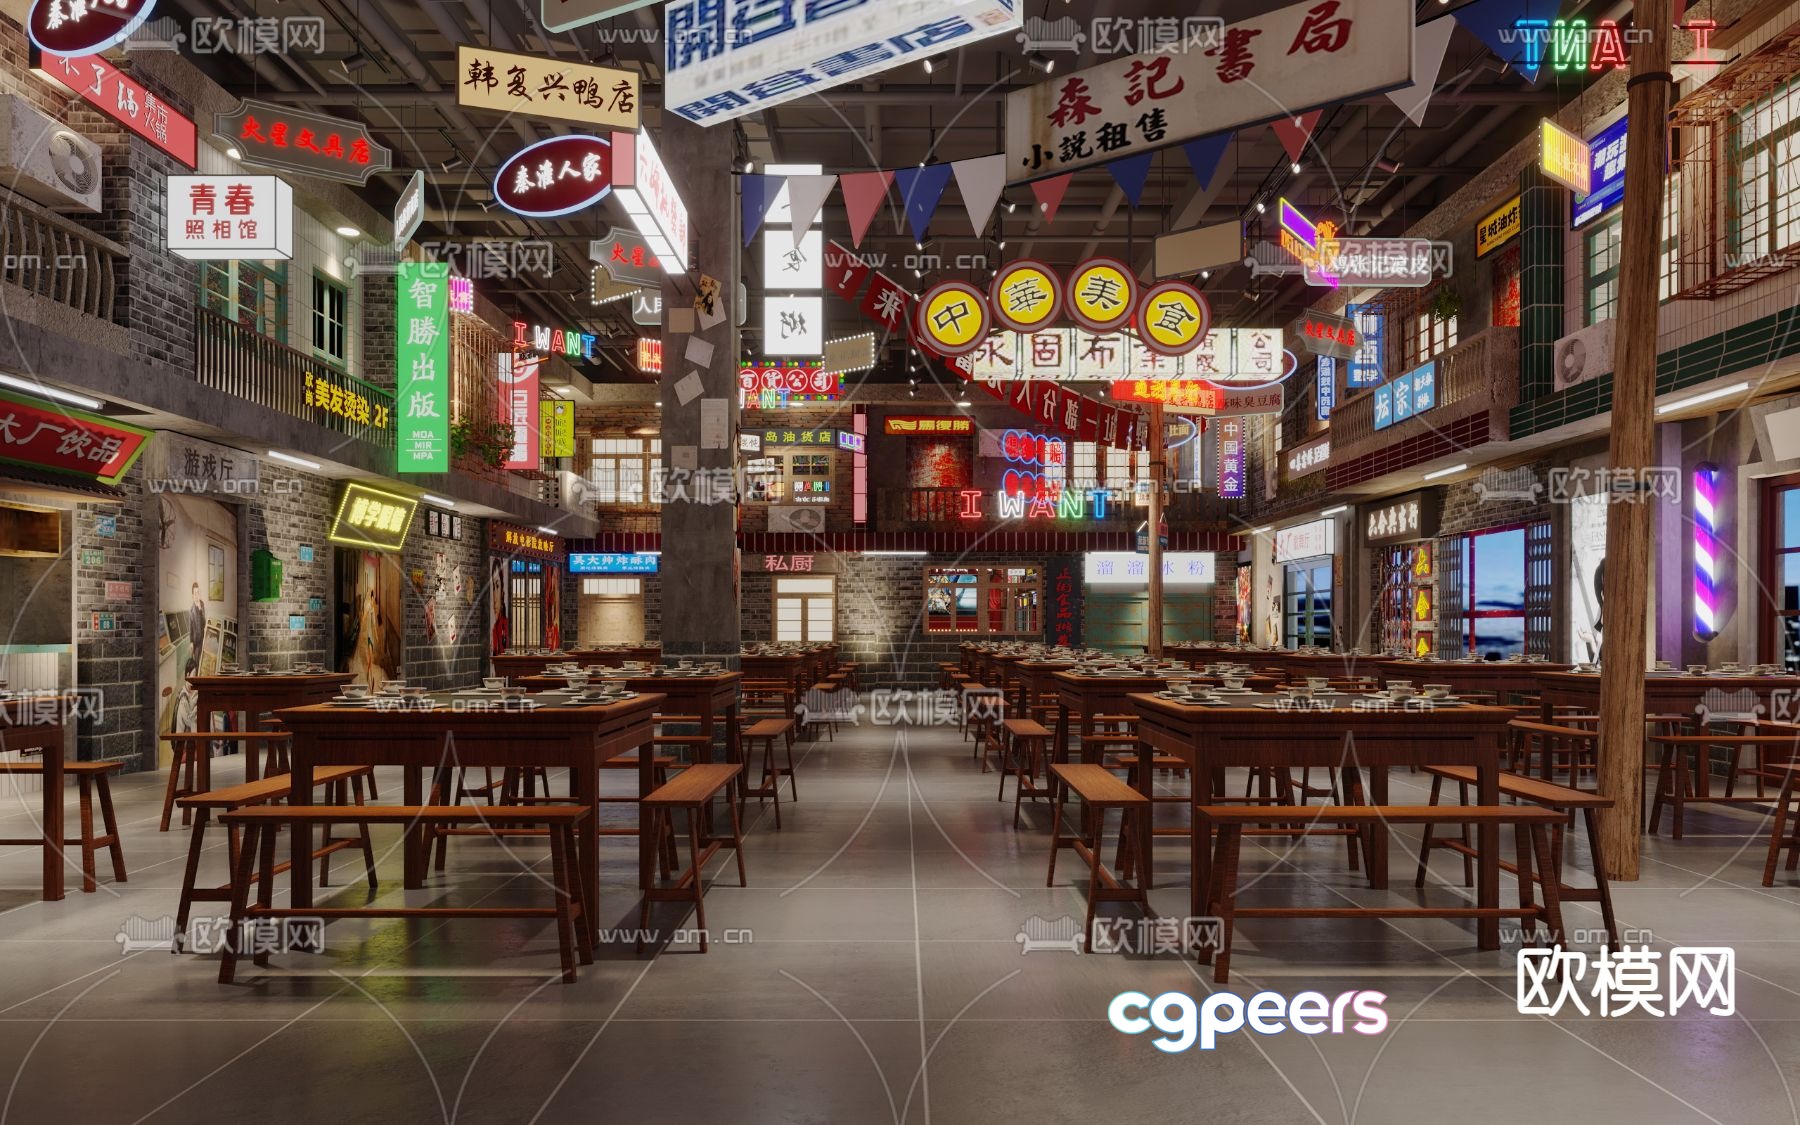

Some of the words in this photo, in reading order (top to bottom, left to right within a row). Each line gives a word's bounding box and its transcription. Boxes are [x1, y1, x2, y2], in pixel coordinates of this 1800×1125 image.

[1046, 1, 1353, 128] 森記書局
[464, 58, 638, 114] 韩复兴鸭店
[241, 116, 371, 165] 火星文具店
[513, 152, 602, 195] 秦淮人家
[189, 183, 255, 216] 青春
[185, 219, 259, 241] 照相馆
[407, 278, 440, 418] 智勝出版
[514, 322, 527, 346] I
[535, 325, 595, 358] WANT
[315, 378, 369, 426] 美发烫染
[374, 403, 389, 429] 2F
[412, 430, 434, 439] MOA
[414, 441, 432, 450] MIR
[184, 447, 234, 482] 游戏厅
[413, 451, 434, 461] MPA
[1223, 421, 1239, 492] 中国黄金
[961, 490, 982, 517] I
[998, 490, 1113, 517] WANT
[765, 554, 814, 572] 私厨
